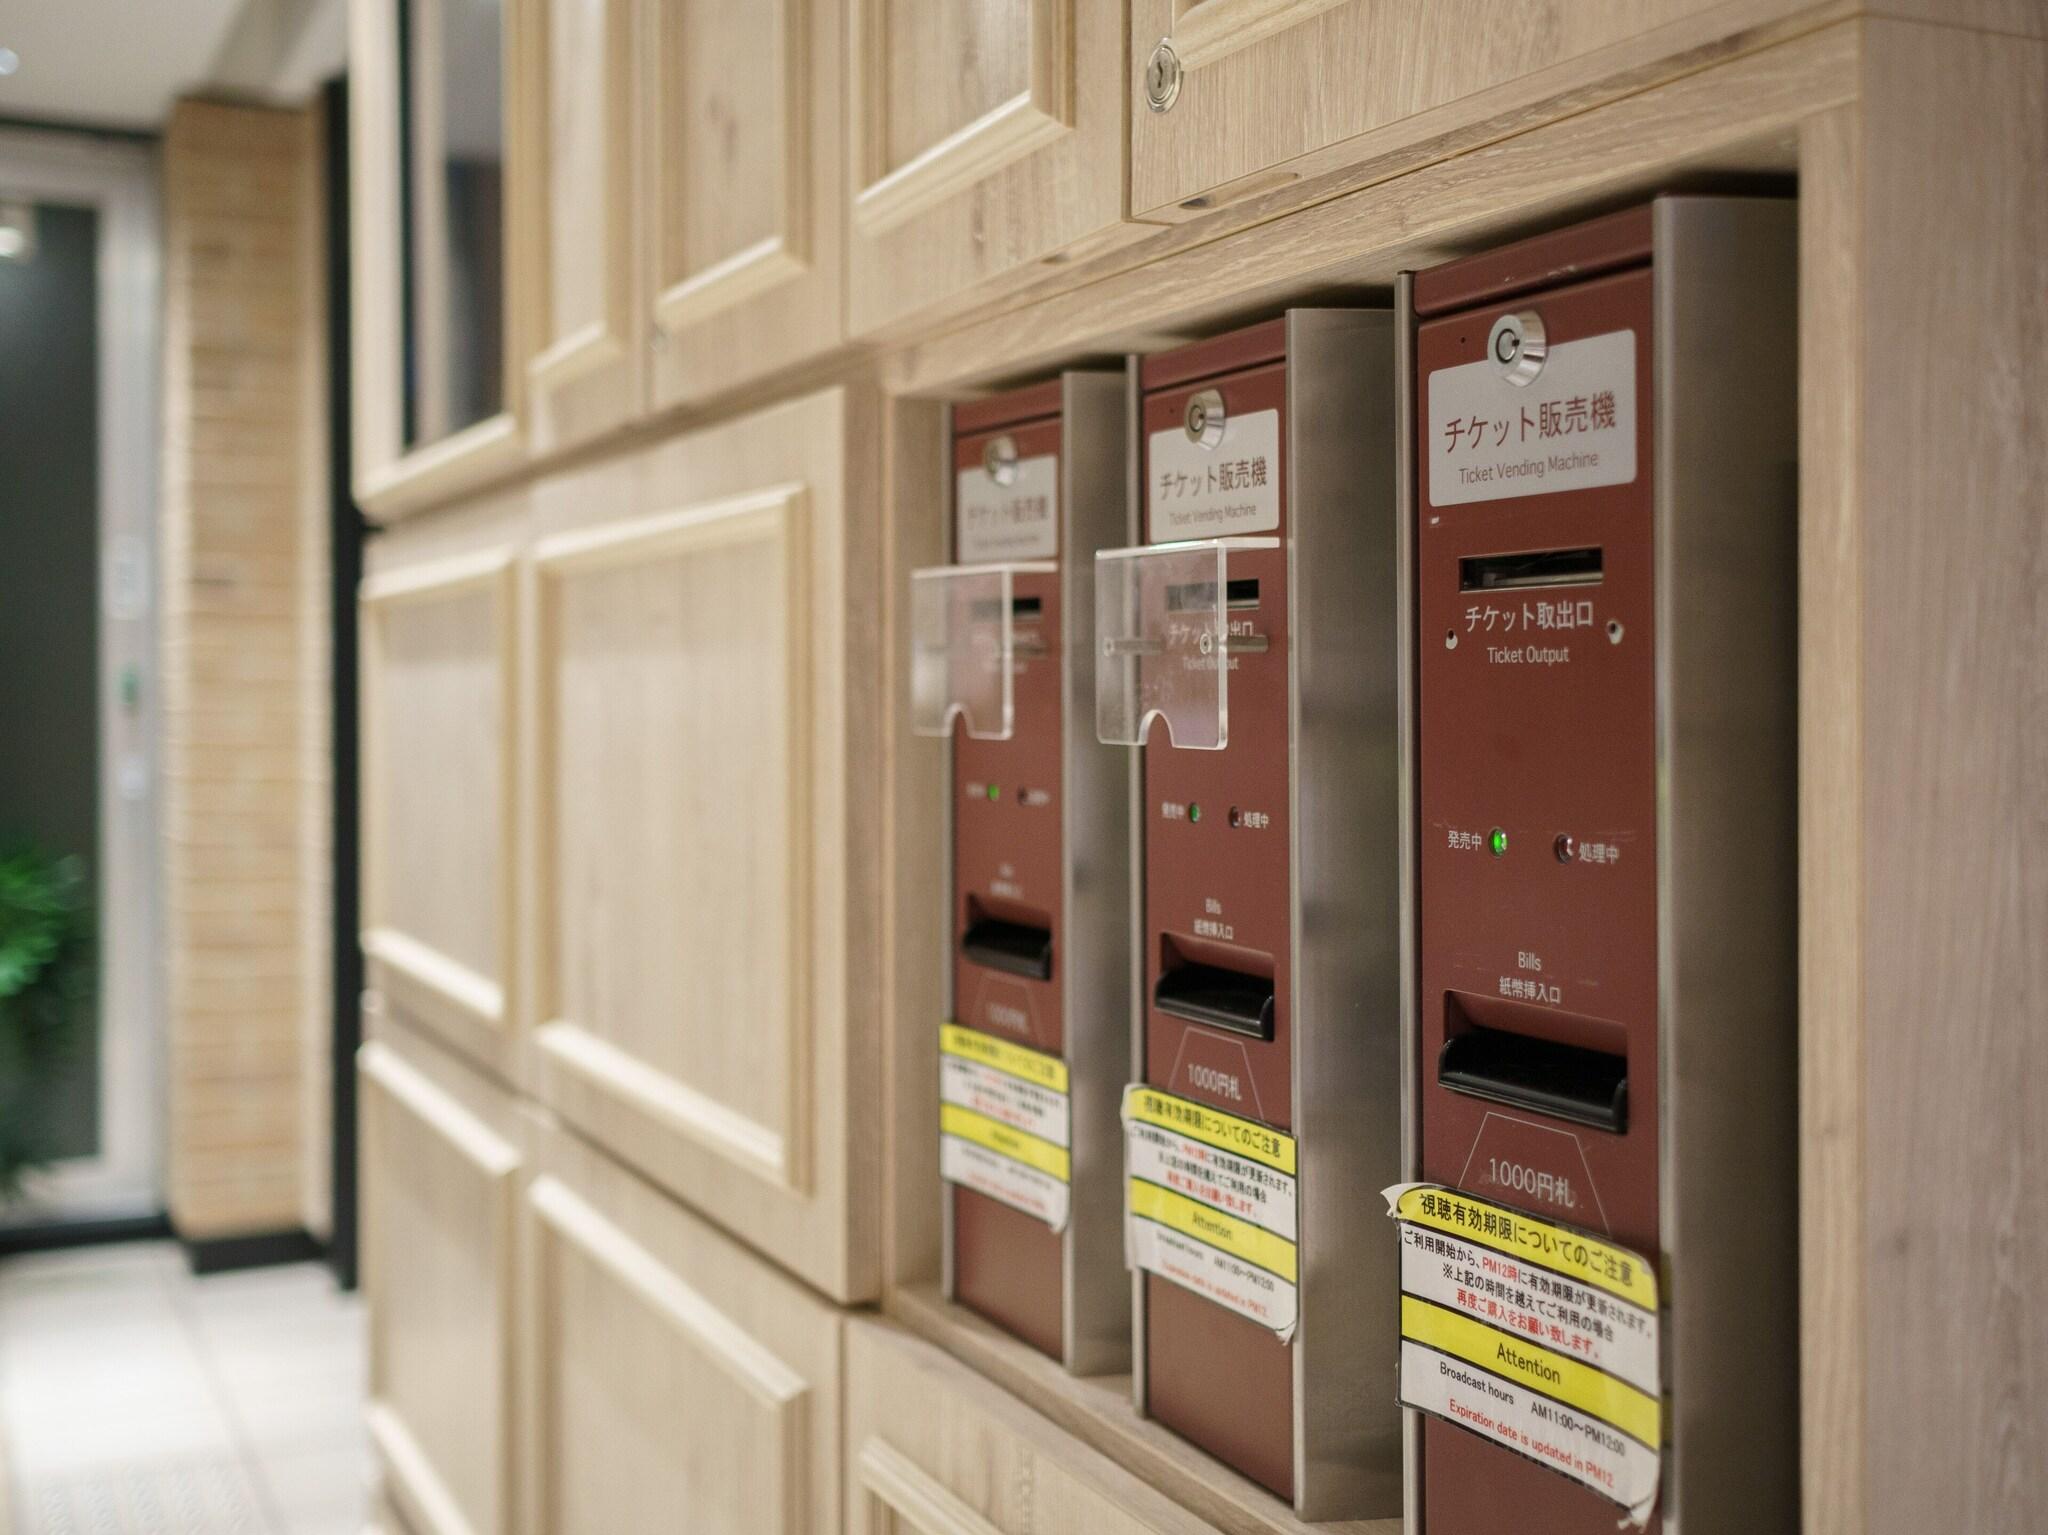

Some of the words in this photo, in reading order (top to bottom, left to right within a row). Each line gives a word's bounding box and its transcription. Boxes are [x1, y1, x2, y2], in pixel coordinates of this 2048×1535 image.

[1444, 390, 1616, 454] チケット販売機
[1160, 456, 1267, 500] チケット販売機
[1459, 466, 1493, 485] Ticket
[1496, 459, 1544, 479] Vending
[1548, 451, 1599, 471] Machine
[1465, 600, 1594, 633] チケット取出口
[1487, 646, 1524, 664] Ticket
[1527, 645, 1570, 667] Output
[1447, 830, 1482, 851] 発売中
[1578, 842, 1620, 864] 処理中
[1518, 951, 1542, 972] Bills
[1499, 976, 1561, 1004] 紙幣挿入口
[1188, 1063, 1242, 1101] 1000円札
[1489, 1157, 1575, 1209] 1000円札
[1419, 1193, 1633, 1287] 視聴有効期限についてのご注意
[1497, 1342, 1561, 1385] Attention
[1440, 1361, 1486, 1393] Broadcast
[1488, 1381, 1514, 1405] hours
[1449, 1398, 1494, 1431] Expiration
[1497, 1421, 1518, 1441] date
[1520, 1430, 1529, 1446] is
[1532, 1439, 1572, 1466] updated
[1574, 1455, 1583, 1472] in
